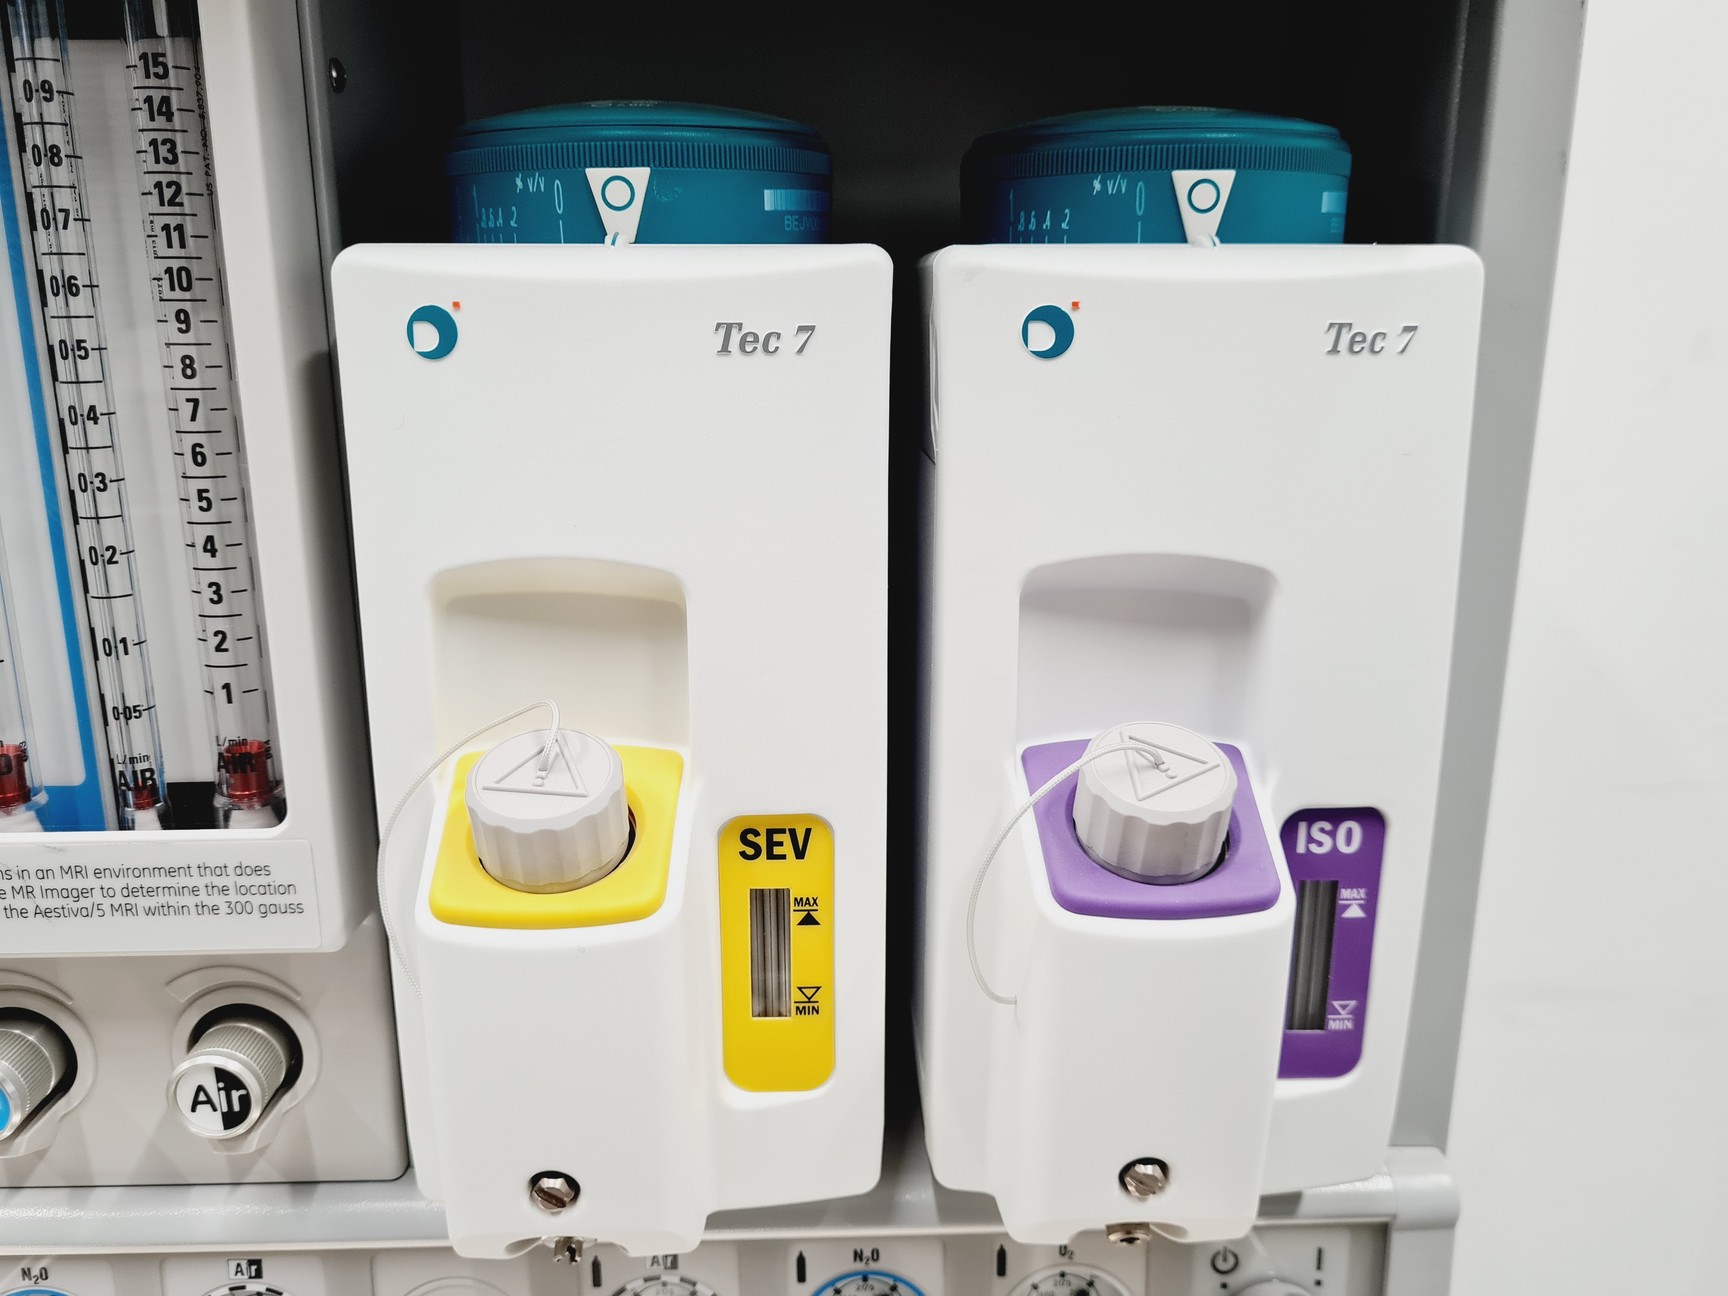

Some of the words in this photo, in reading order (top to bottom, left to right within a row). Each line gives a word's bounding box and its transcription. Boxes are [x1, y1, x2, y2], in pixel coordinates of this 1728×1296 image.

[139, 52, 170, 80] 15
[143, 95, 174, 122] 14
[148, 138, 179, 165] 13
[154, 180, 184, 207] 12
[161, 223, 186, 249] 11
[164, 266, 192, 292] 10
[174, 308, 192, 334] 9
[714, 322, 782, 356] Tec
[794, 324, 817, 355] 7
[1325, 322, 1388, 356] Tec
[1396, 325, 1419, 355] 7
[180, 354, 198, 380] 8
[185, 398, 200, 422] 7
[191, 442, 208, 468] 6
[196, 488, 212, 512] 5
[202, 535, 218, 558] 4
[207, 582, 224, 605] 3
[213, 630, 230, 653] 2
[221, 682, 233, 704] 1
[118, 767, 157, 792] AIR
[738, 827, 812, 862] SEV
[1296, 820, 1363, 854] ISO
[16, 865, 31, 880] in
[36, 868, 56, 880] an
[60, 865, 89, 880] MRI
[94, 864, 194, 879] environment
[197, 863, 230, 878] that
[234, 862, 272, 876] does
[12, 885, 36, 900] MR
[40, 884, 96, 902] Imager
[100, 884, 116, 898] to
[120, 882, 200, 898] determine
[204, 882, 230, 897] the
[234, 880, 297, 896] location
[793, 896, 819, 908] MAX
[1339, 888, 1366, 899] MAX
[4, 904, 29, 918] the
[34, 902, 106, 918] Aestiva/5
[110, 902, 140, 917] MRI
[143, 901, 191, 917] within
[194, 900, 220, 916] the
[225, 901, 254, 916] 300
[258, 903, 305, 918] gauss
[795, 1005, 820, 1016] MIN
[1328, 1020, 1354, 1030] MIN
[190, 1082, 248, 1113] Air
